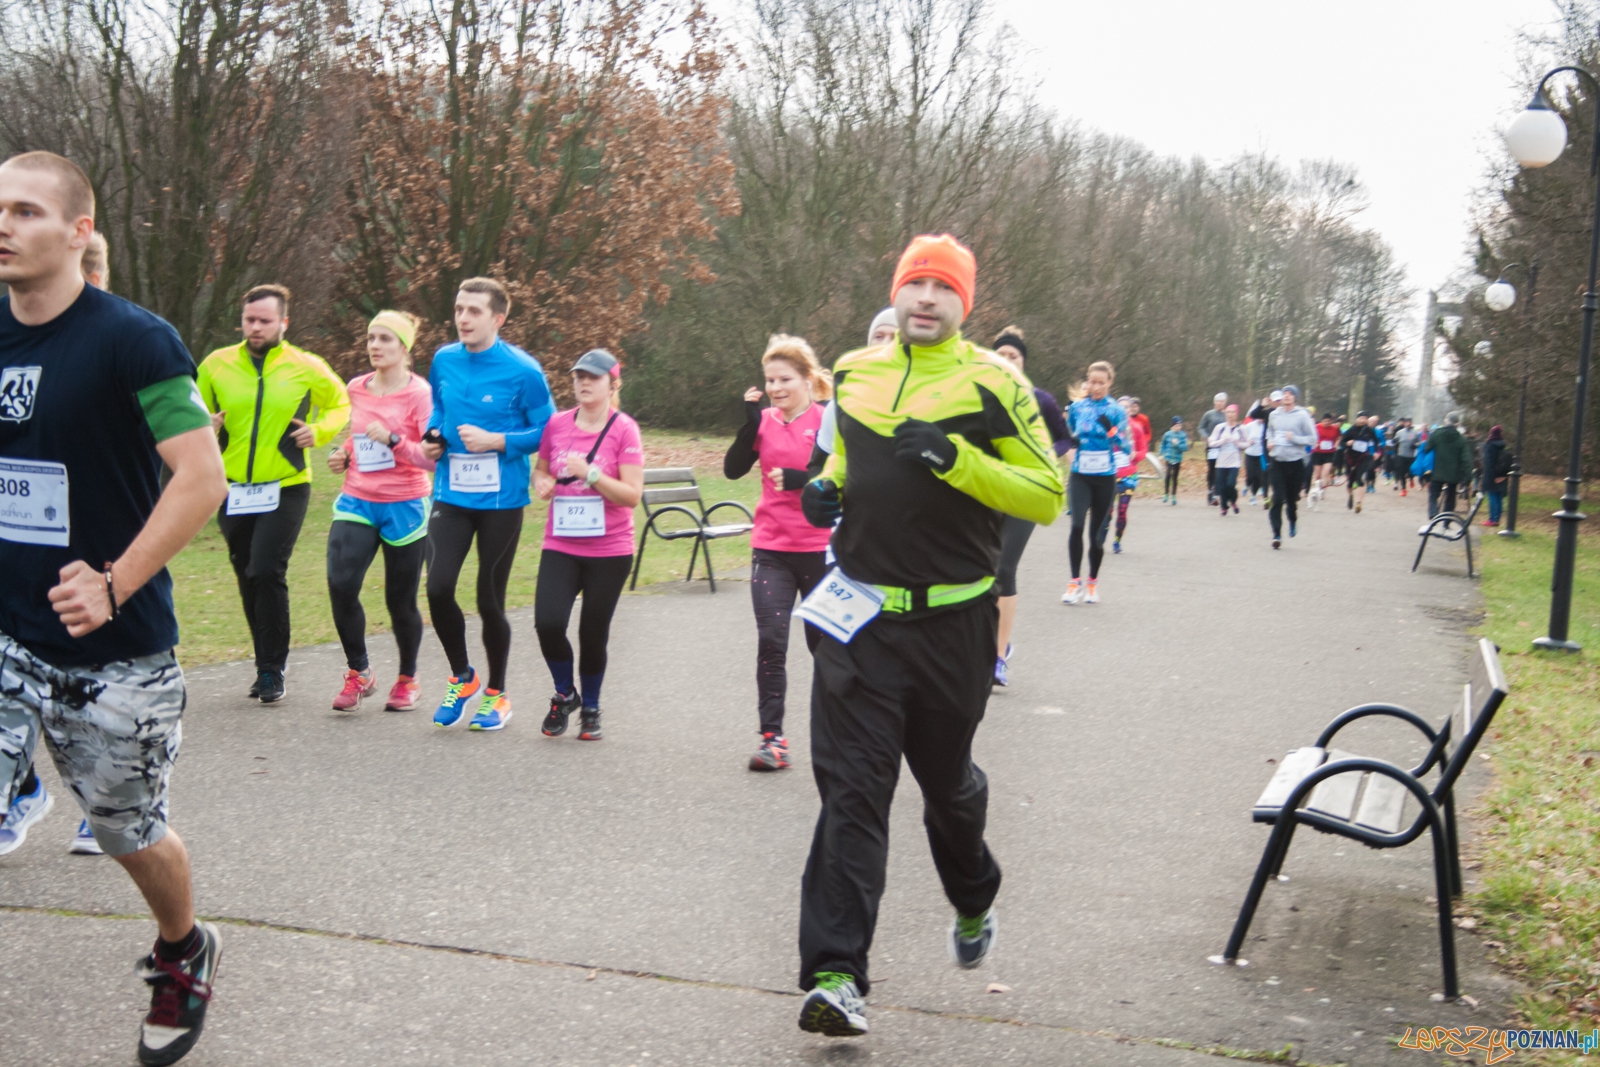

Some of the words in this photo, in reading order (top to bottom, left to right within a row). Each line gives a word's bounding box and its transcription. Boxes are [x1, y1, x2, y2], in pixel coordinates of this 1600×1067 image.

[462, 463, 480, 472] 874
[246, 487, 263, 496] 618
[567, 506, 585, 515] 872
[825, 581, 854, 601] 847
